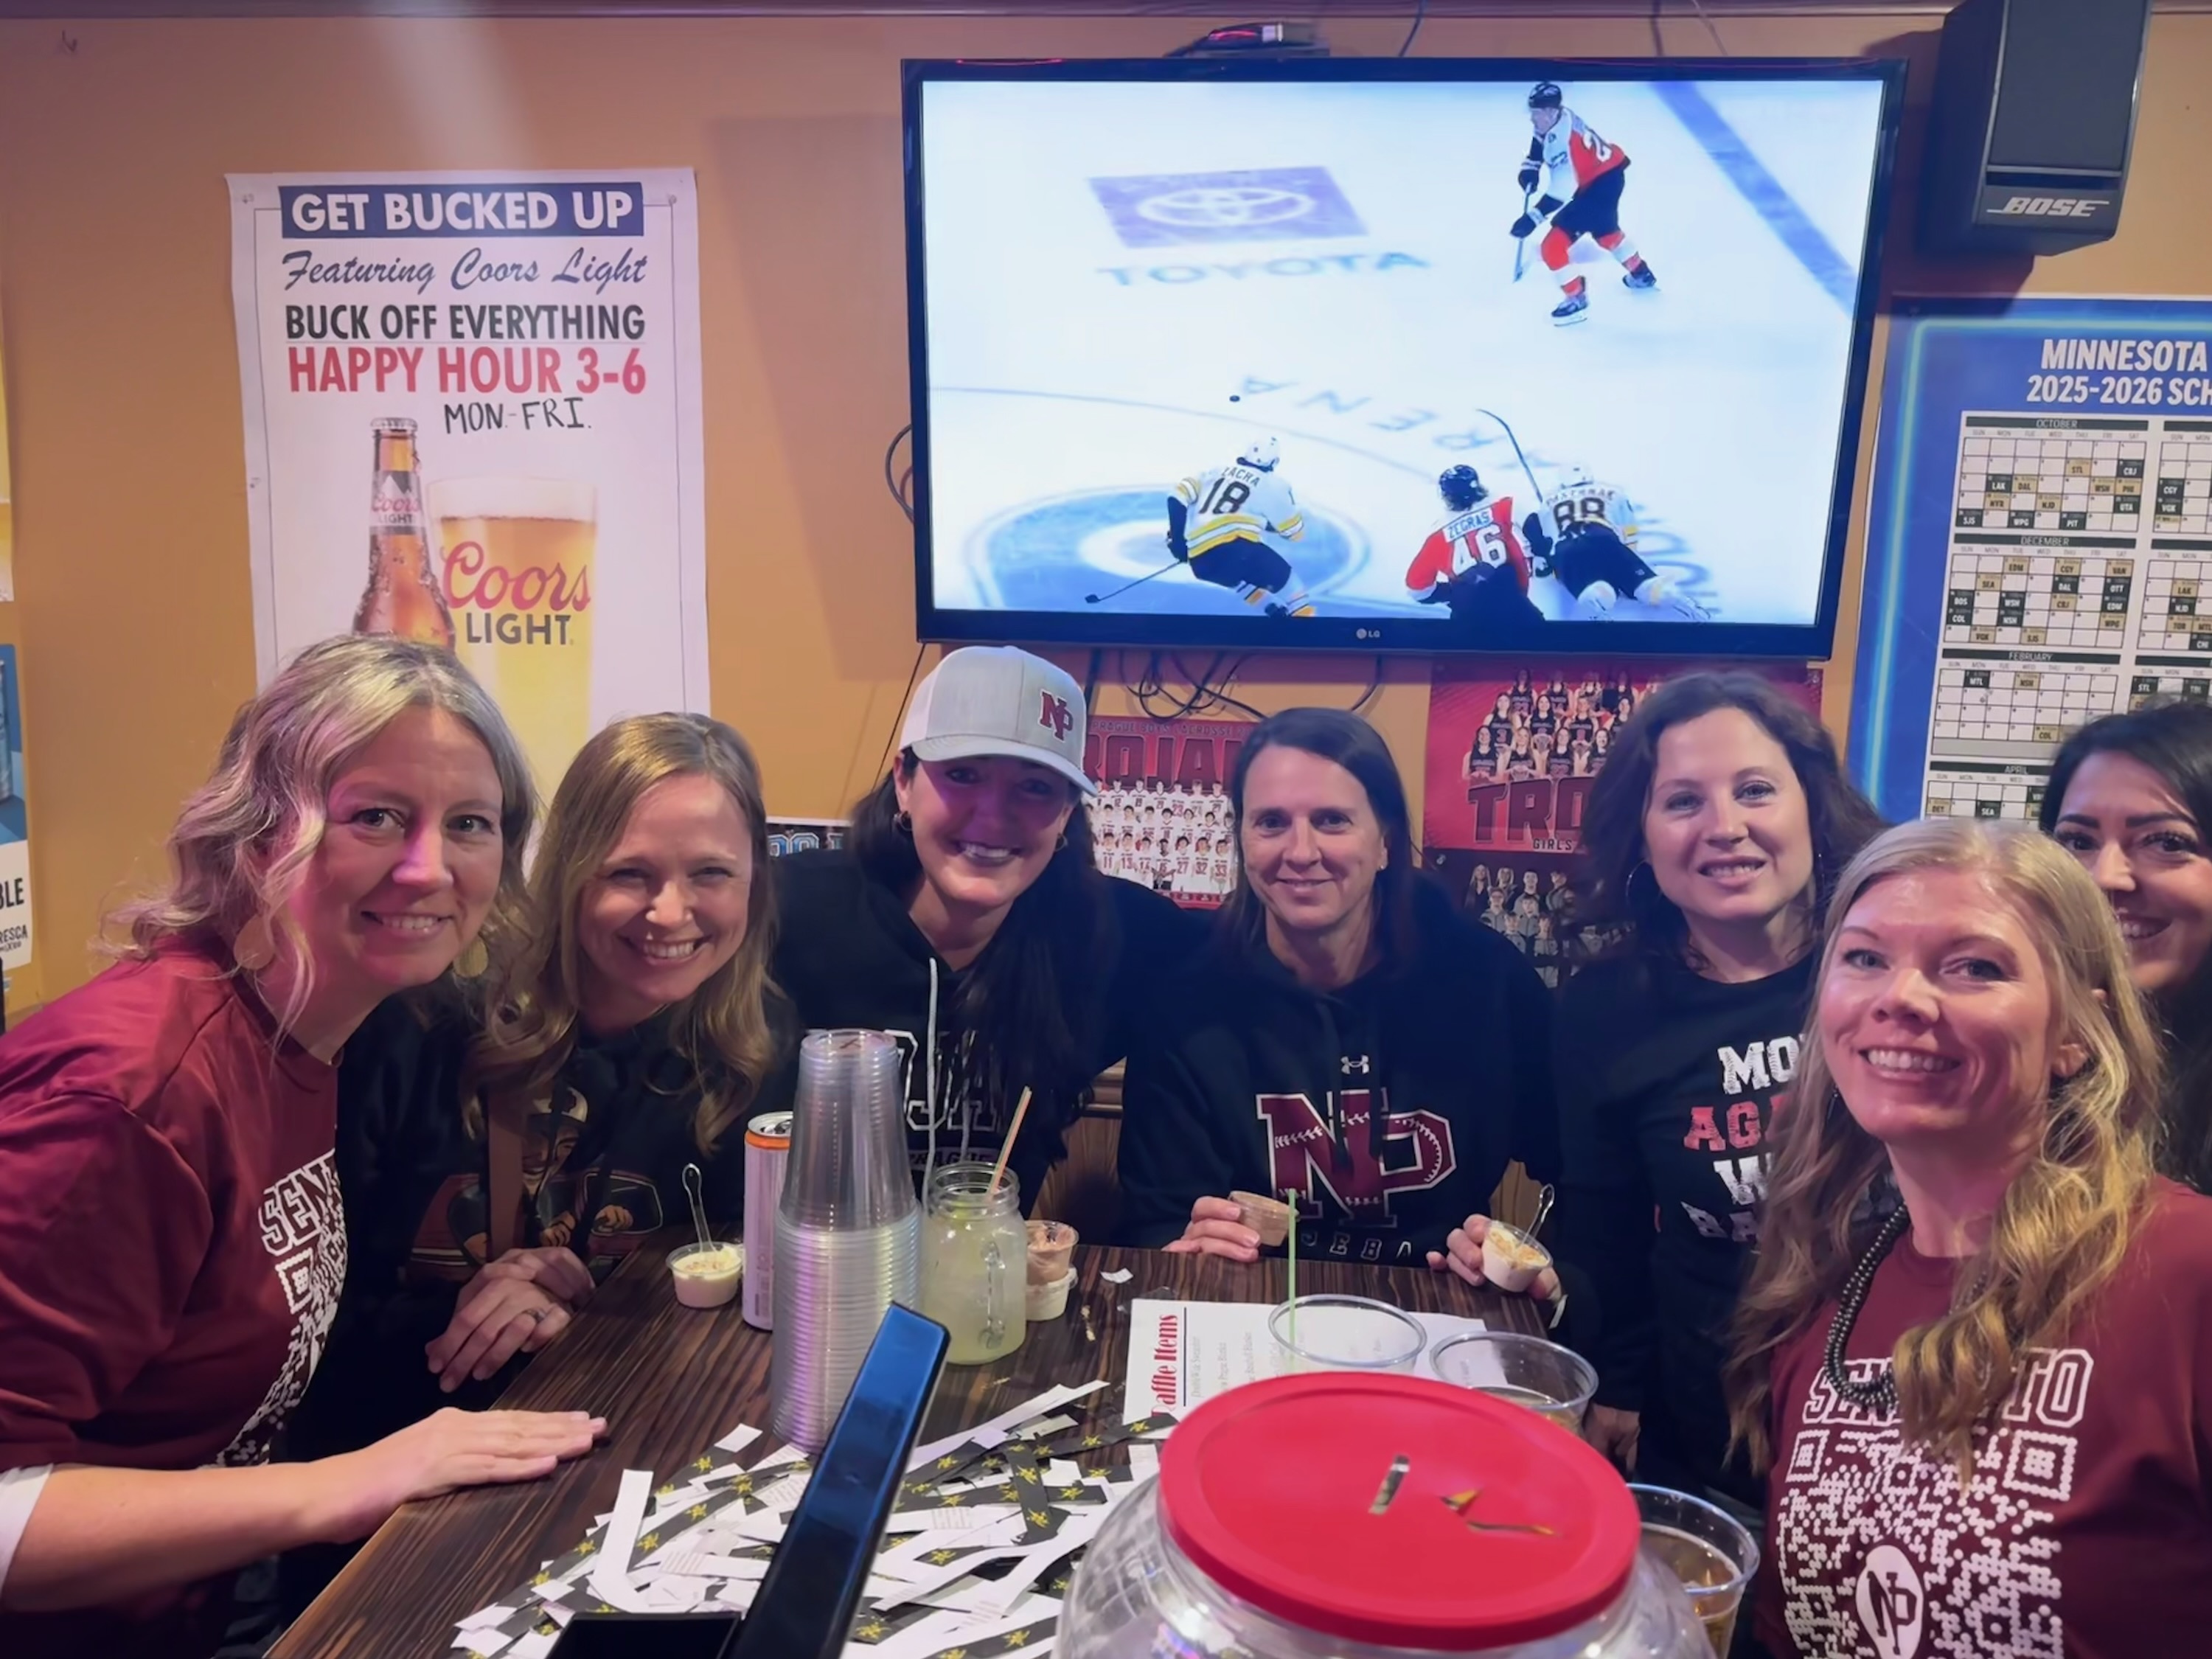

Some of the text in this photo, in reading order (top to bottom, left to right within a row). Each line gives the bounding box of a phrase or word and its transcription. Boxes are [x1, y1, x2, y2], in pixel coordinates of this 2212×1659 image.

[292, 190, 633, 232] GET BUCKED UP
[1986, 197, 2109, 217] BOSE
[283, 247, 647, 294] Featuring Coors Light
[1096, 252, 1431, 286] TOYOTA
[285, 304, 646, 341] BUCK OFF EVERYTHING
[288, 347, 647, 395] HAPPY HOUR 3-6
[2040, 338, 2208, 372] MINNESOTA
[2026, 375, 2162, 405] 2025-2026
[2036, 419, 2078, 428] OCTOBER
[1198, 477, 1250, 514] 18
[1992, 482, 2006, 490] LAK
[378, 514, 412, 524] LIGHT
[1554, 497, 1605, 538] 88
[1452, 523, 1506, 576] 46
[2021, 537, 2070, 546] DECEMBER
[443, 541, 591, 612] Coors
[466, 613, 574, 645] LIGHT
[2009, 652, 2053, 661] FEBRUARY
[1969, 678, 1983, 686] MTL
[1038, 689, 1075, 742] NP
[2005, 765, 2028, 774] APRIL
[1981, 807, 1994, 815] SEA
[1533, 838, 1573, 850] GIRLS
[1717, 1034, 1805, 1094] MO
[1256, 1089, 1457, 1228] NP
[1153, 1315, 1178, 1361] Items
[1867, 1571, 1919, 1658] NP
